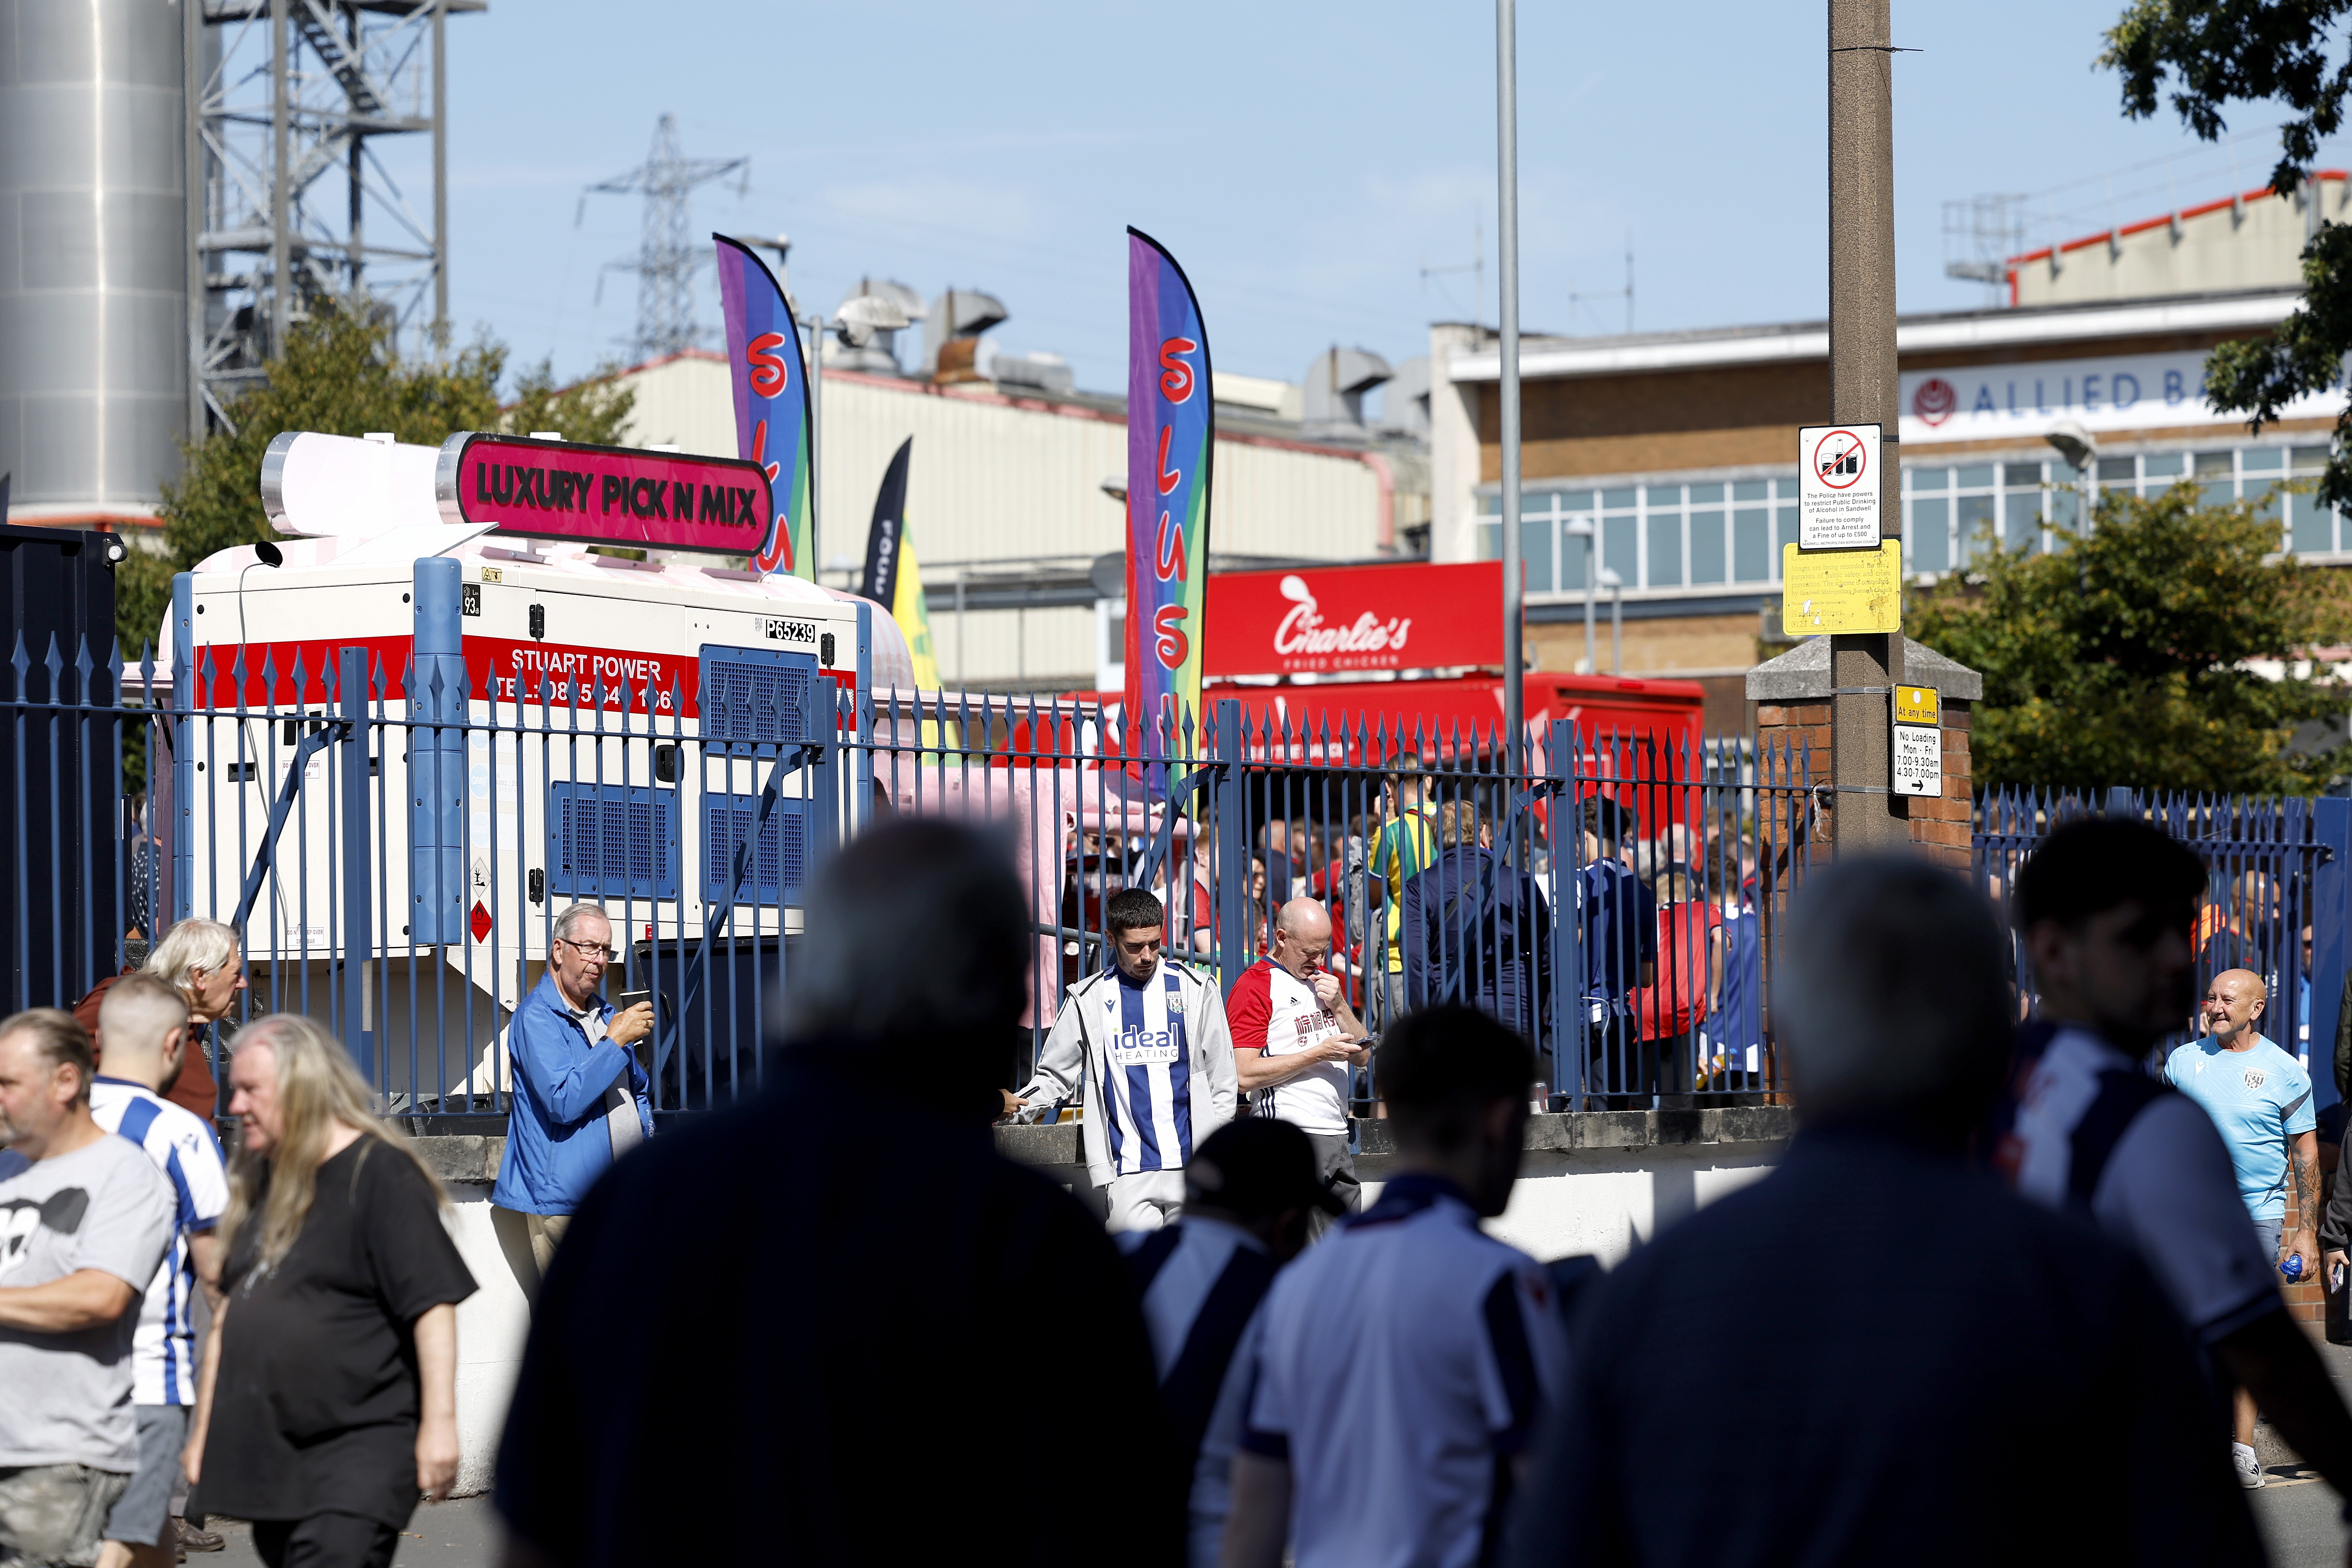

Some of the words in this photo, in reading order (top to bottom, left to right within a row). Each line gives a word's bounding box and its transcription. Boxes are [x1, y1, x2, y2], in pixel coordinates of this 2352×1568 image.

[1971, 371, 2143, 419] ALLIED
[477, 462, 594, 511] LUXURY
[602, 474, 668, 517] PICK
[673, 482, 694, 520] N
[699, 484, 757, 526] MIX
[465, 597, 475, 614] 93
[767, 619, 815, 642] P65239
[1274, 602, 1411, 655] Charlie's
[512, 649, 588, 674] STUART
[593, 655, 661, 681] POWER
[1283, 657, 1328, 669] FRIED
[1333, 655, 1399, 667] CHICKEN
[549, 681, 592, 702] 085
[1898, 706, 1906, 716] At
[1909, 709, 1919, 719] any
[1922, 708, 1935, 718] time
[1900, 731, 1909, 740] No
[1912, 732, 1936, 744] Loading
[1904, 744, 1916, 754] Mon
[1897, 755, 1938, 767] 7.00-9.30am
[1897, 767, 1939, 780] 4.30-7.00pm
[1294, 1009, 1336, 1036] 棕榈股
[1114, 1024, 1178, 1050] ideal
[1115, 1049, 1178, 1061] HEATING
